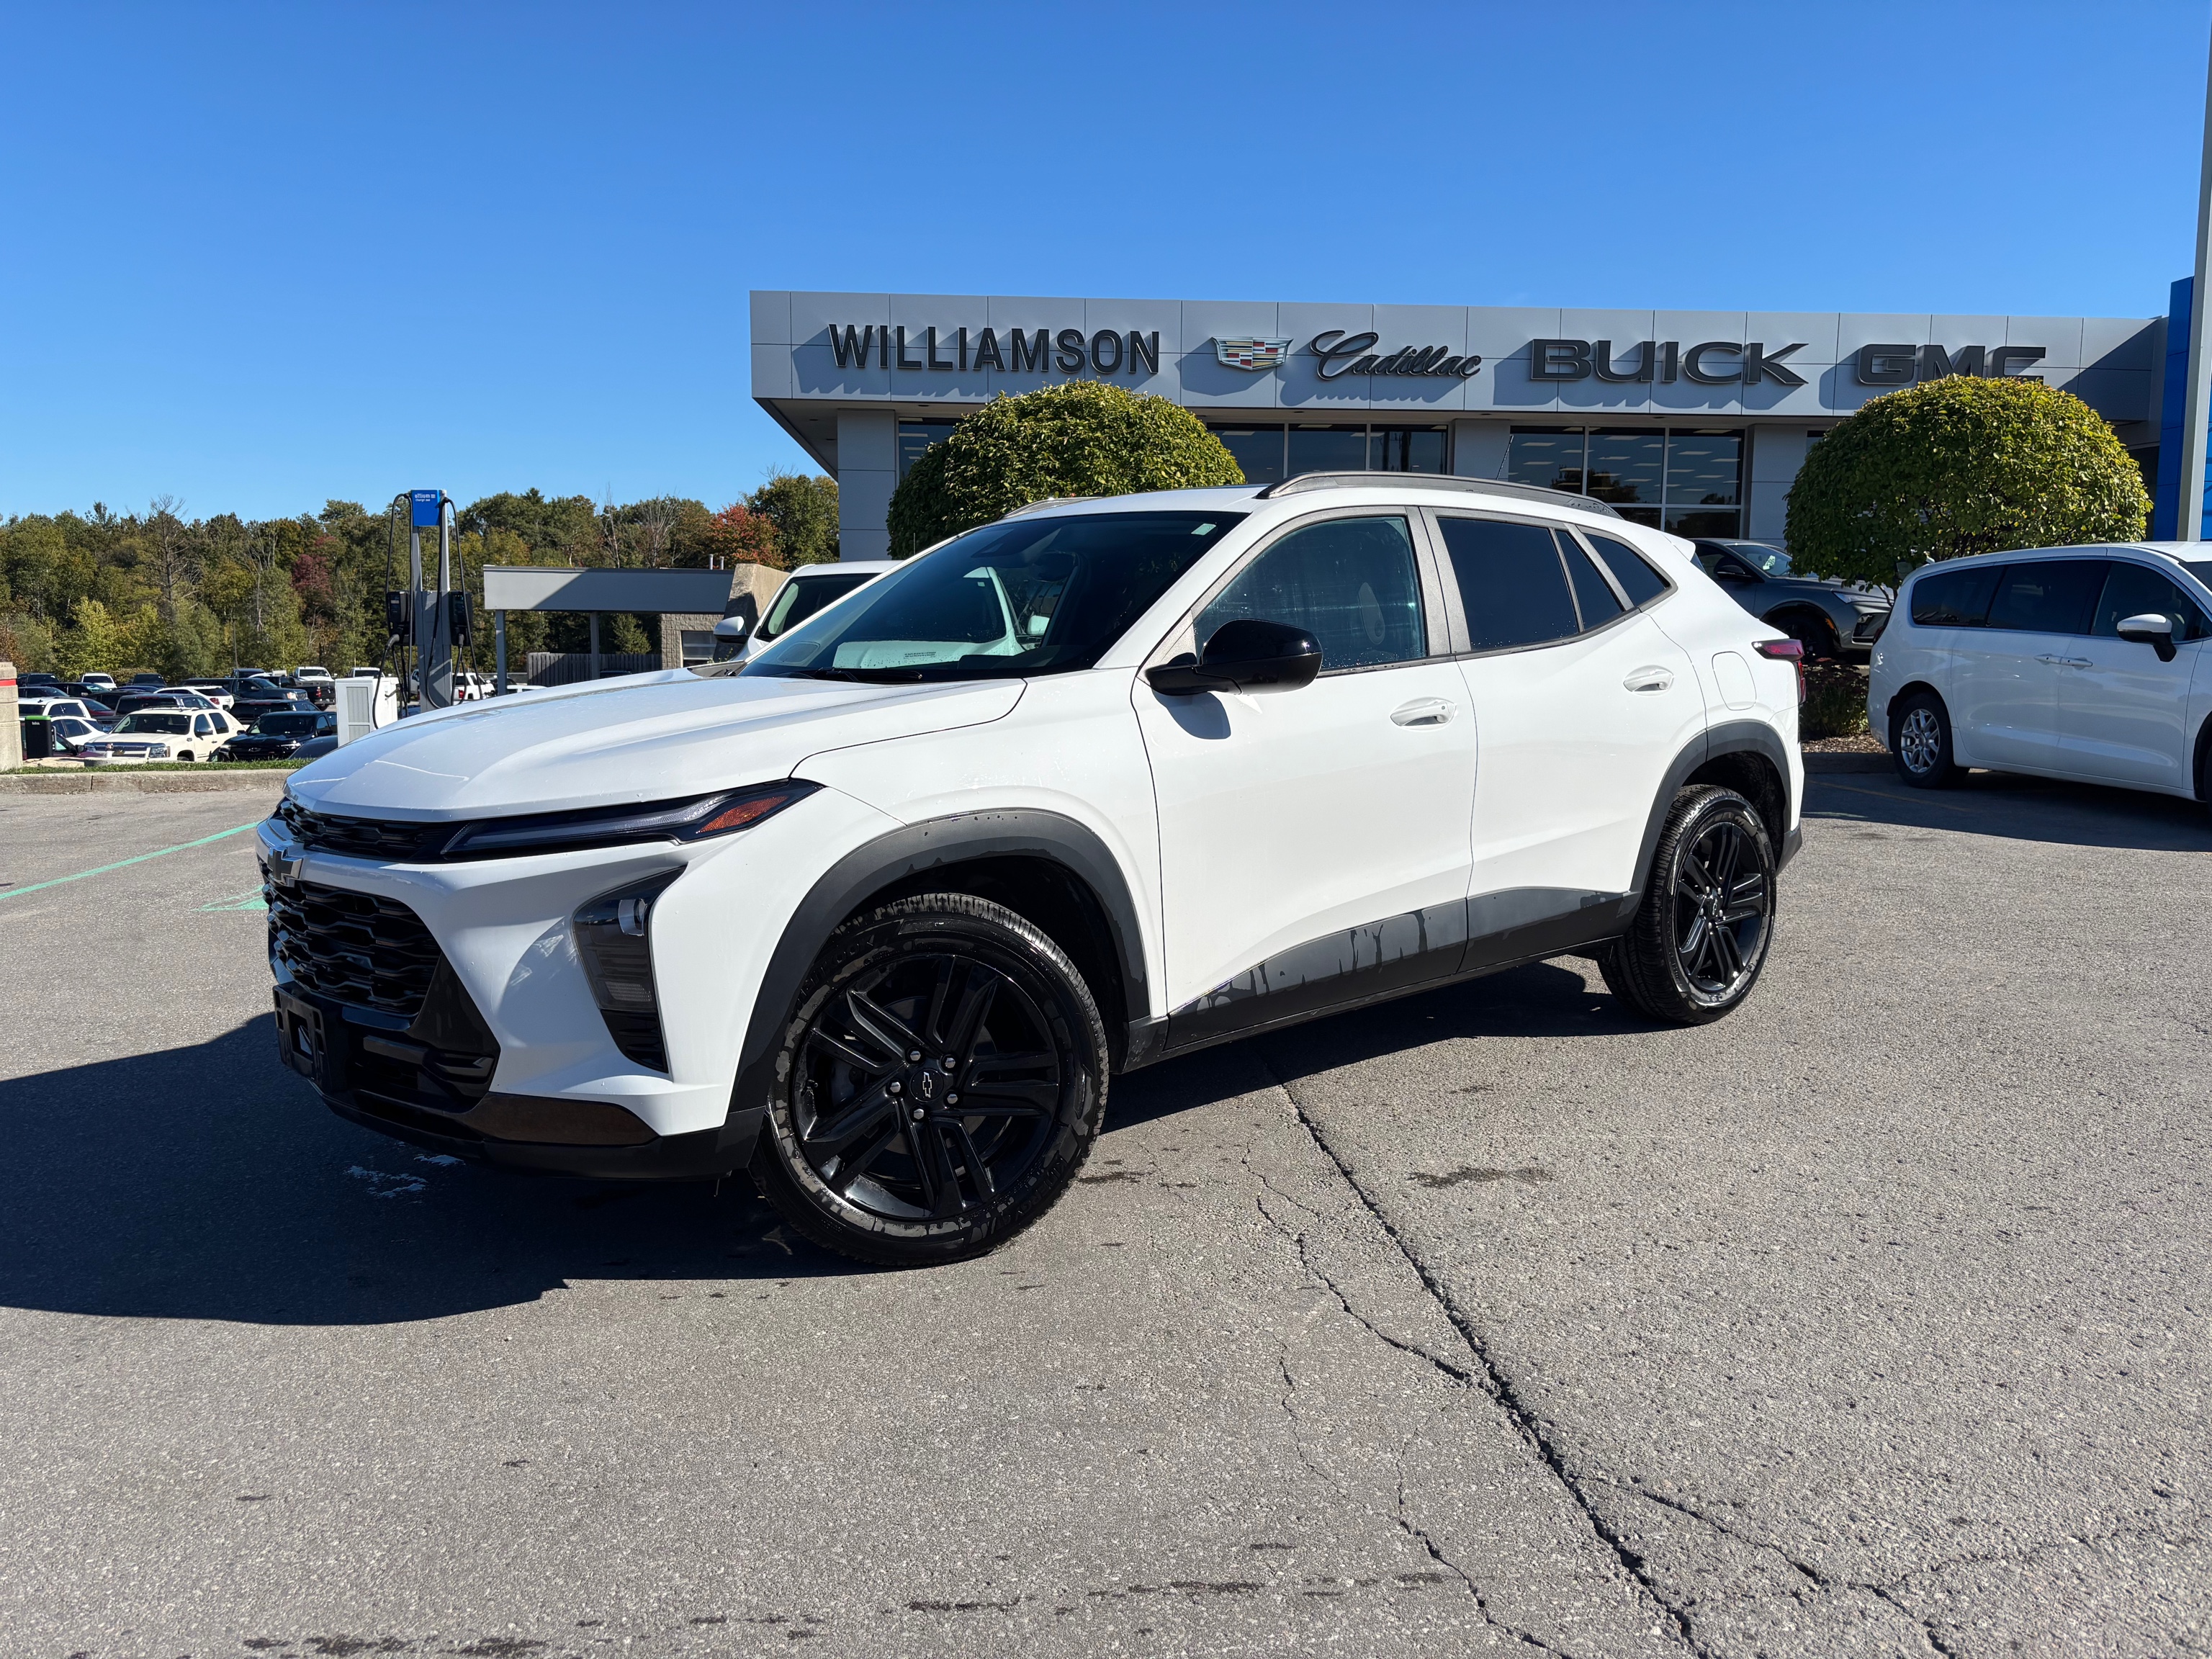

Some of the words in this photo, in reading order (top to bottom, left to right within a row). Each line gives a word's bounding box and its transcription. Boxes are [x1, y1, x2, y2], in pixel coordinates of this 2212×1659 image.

[829, 323, 1159, 374] WILLIAMSON
[1310, 329, 1482, 380] Cadillac
[1532, 338, 1809, 385] BUICK
[1858, 343, 2046, 385] GMC
